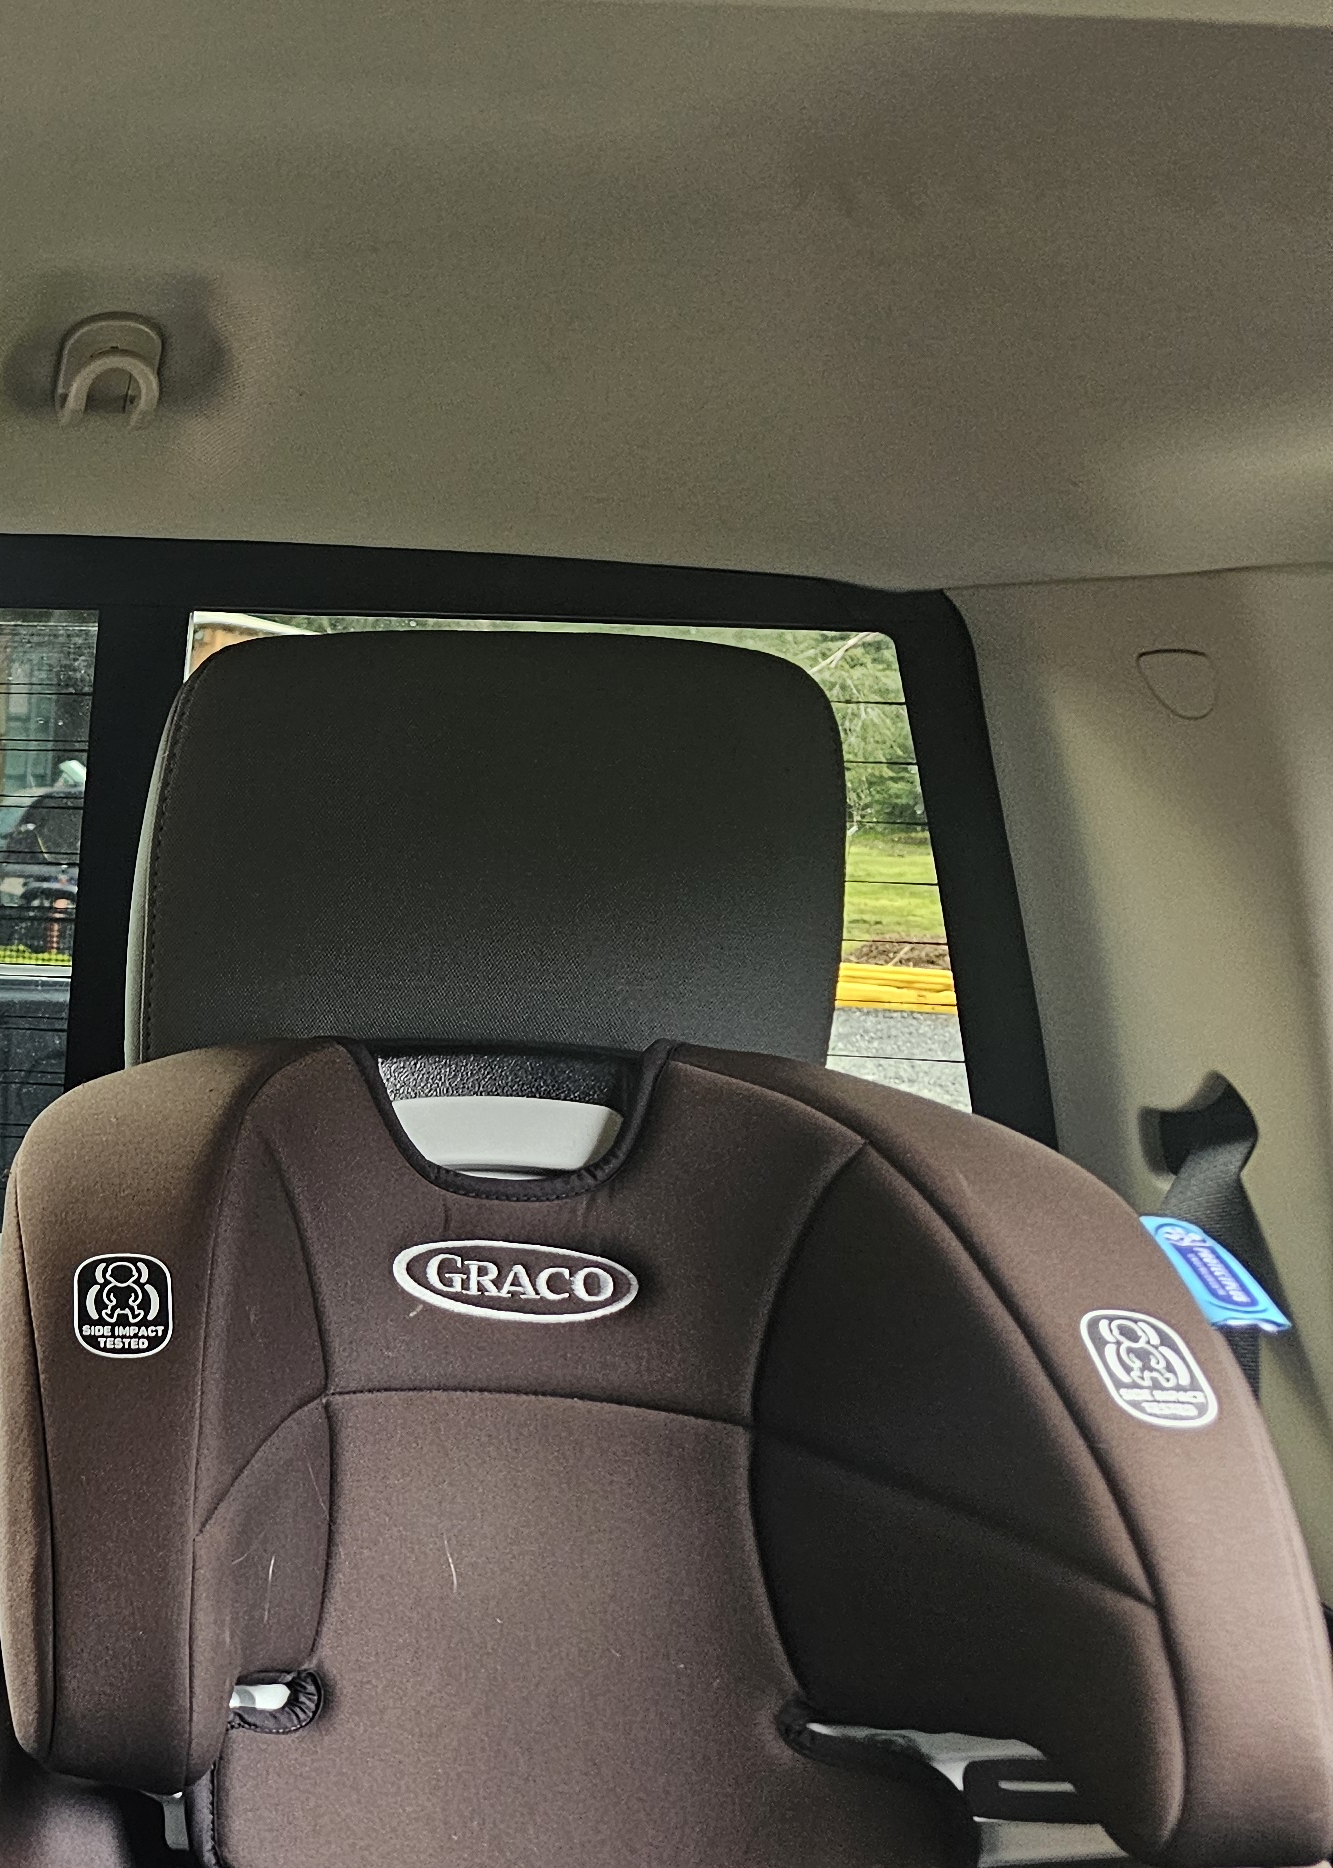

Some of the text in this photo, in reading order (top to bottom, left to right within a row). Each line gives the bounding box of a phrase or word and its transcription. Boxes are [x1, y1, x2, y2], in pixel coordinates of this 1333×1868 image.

[425, 1253, 614, 1302] GRACO
[82, 1324, 165, 1337] SIDE IMPACT
[97, 1338, 149, 1349] TESTED
